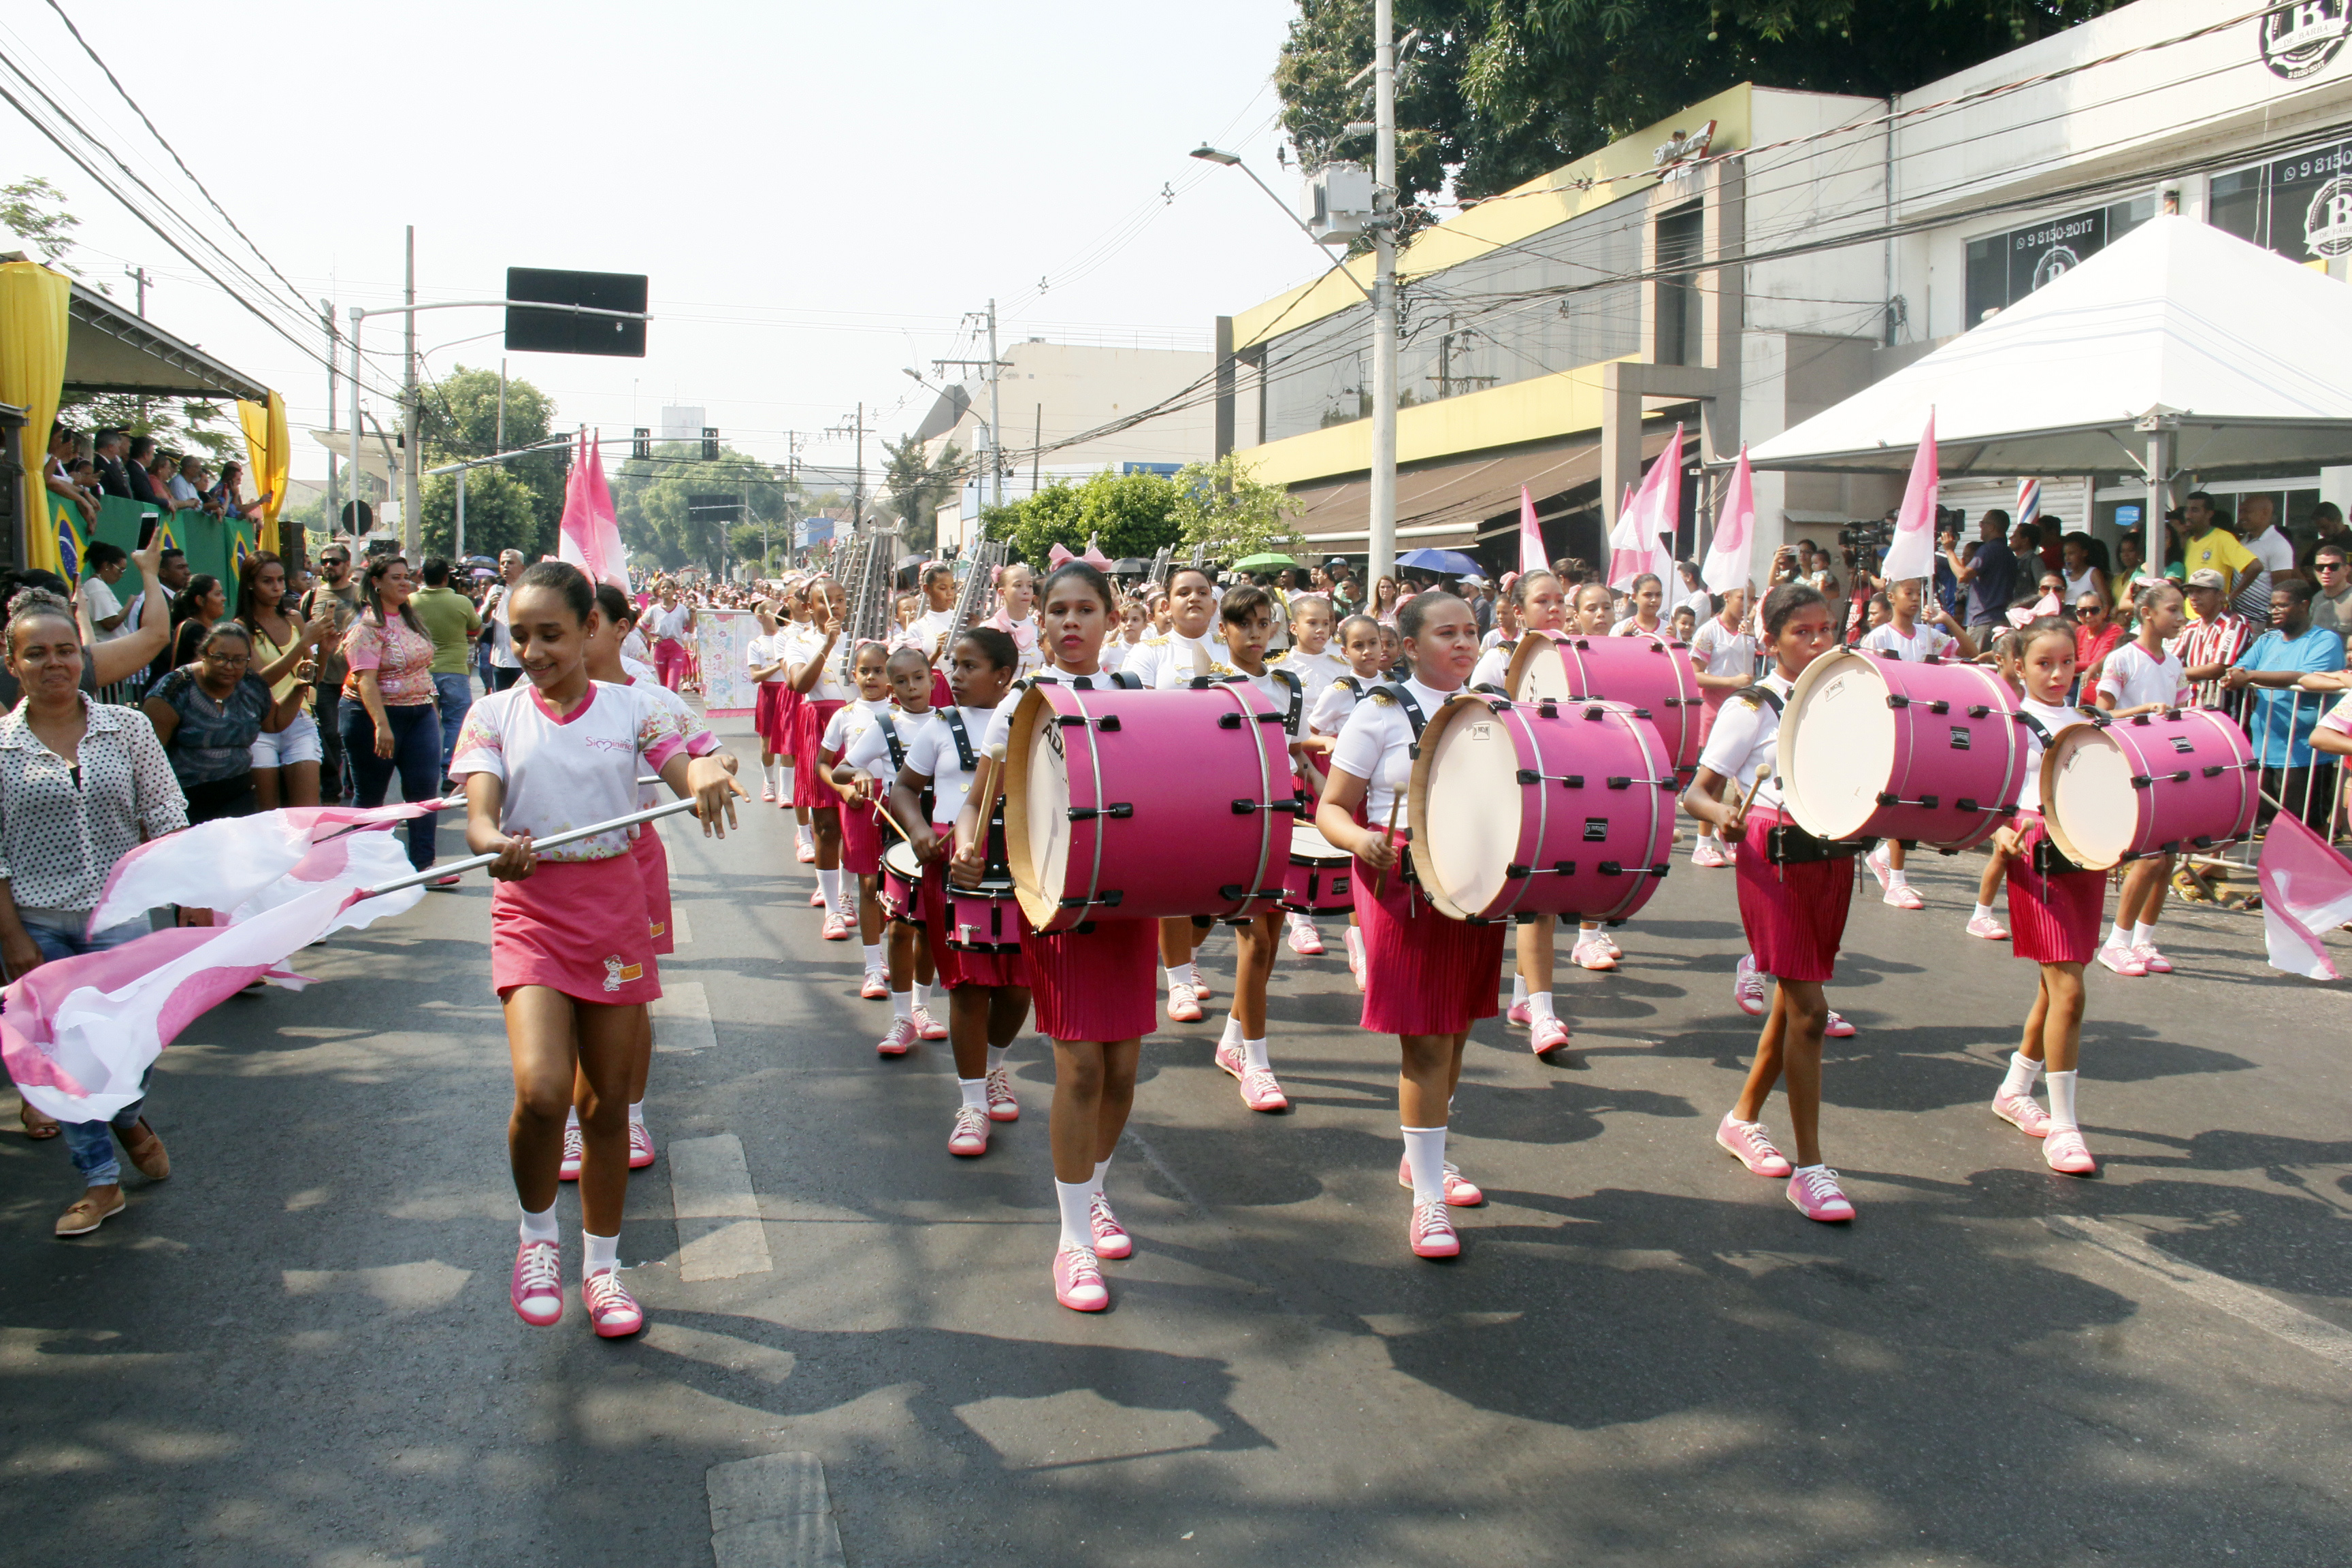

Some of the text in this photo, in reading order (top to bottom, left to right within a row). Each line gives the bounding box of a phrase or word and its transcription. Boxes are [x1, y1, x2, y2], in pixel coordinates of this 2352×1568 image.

[2284, 24, 2328, 47] DE BARBA
[2300, 161, 2310, 177] 9
[2325, 193, 2352, 227] B
[2027, 218, 2094, 247] 9 8150-2017
